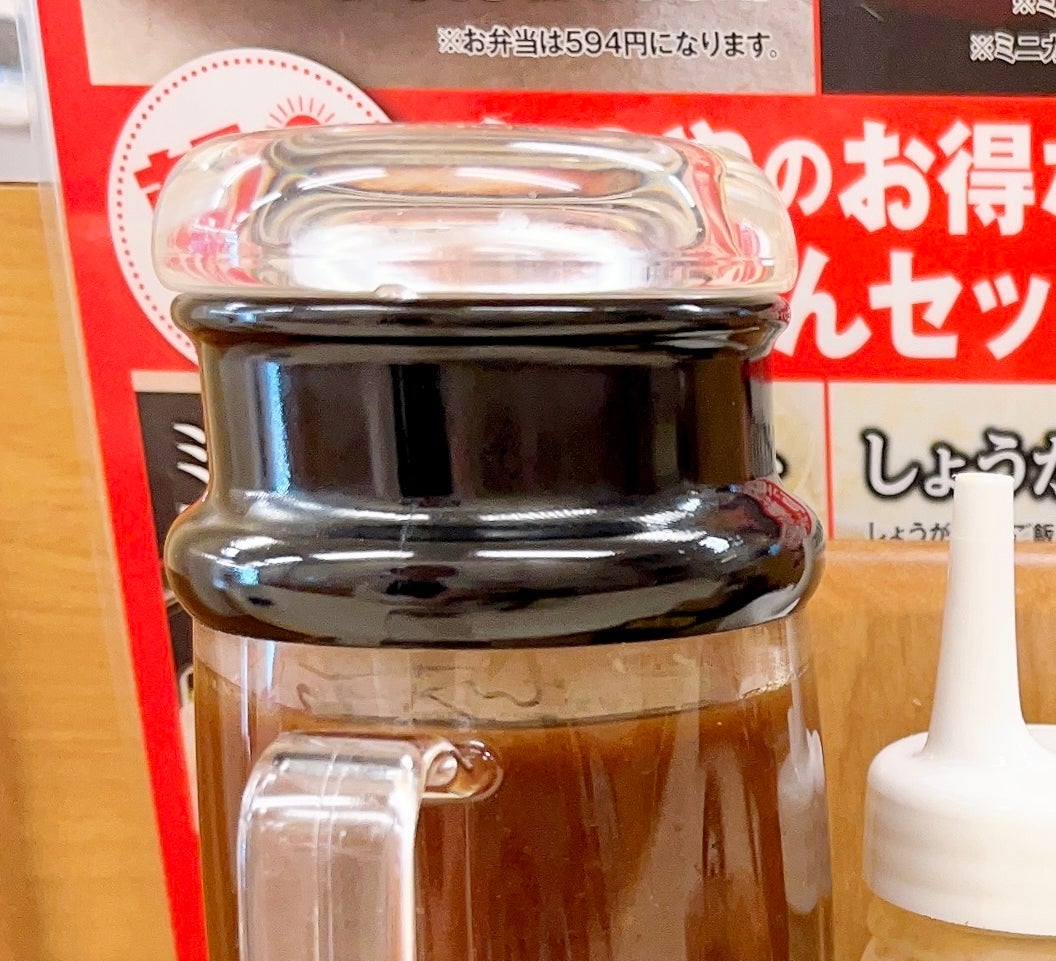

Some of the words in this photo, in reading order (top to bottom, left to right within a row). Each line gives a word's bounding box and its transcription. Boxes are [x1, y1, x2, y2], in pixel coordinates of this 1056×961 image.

[437, 25, 779, 60] ※お弁当は594円になります。
